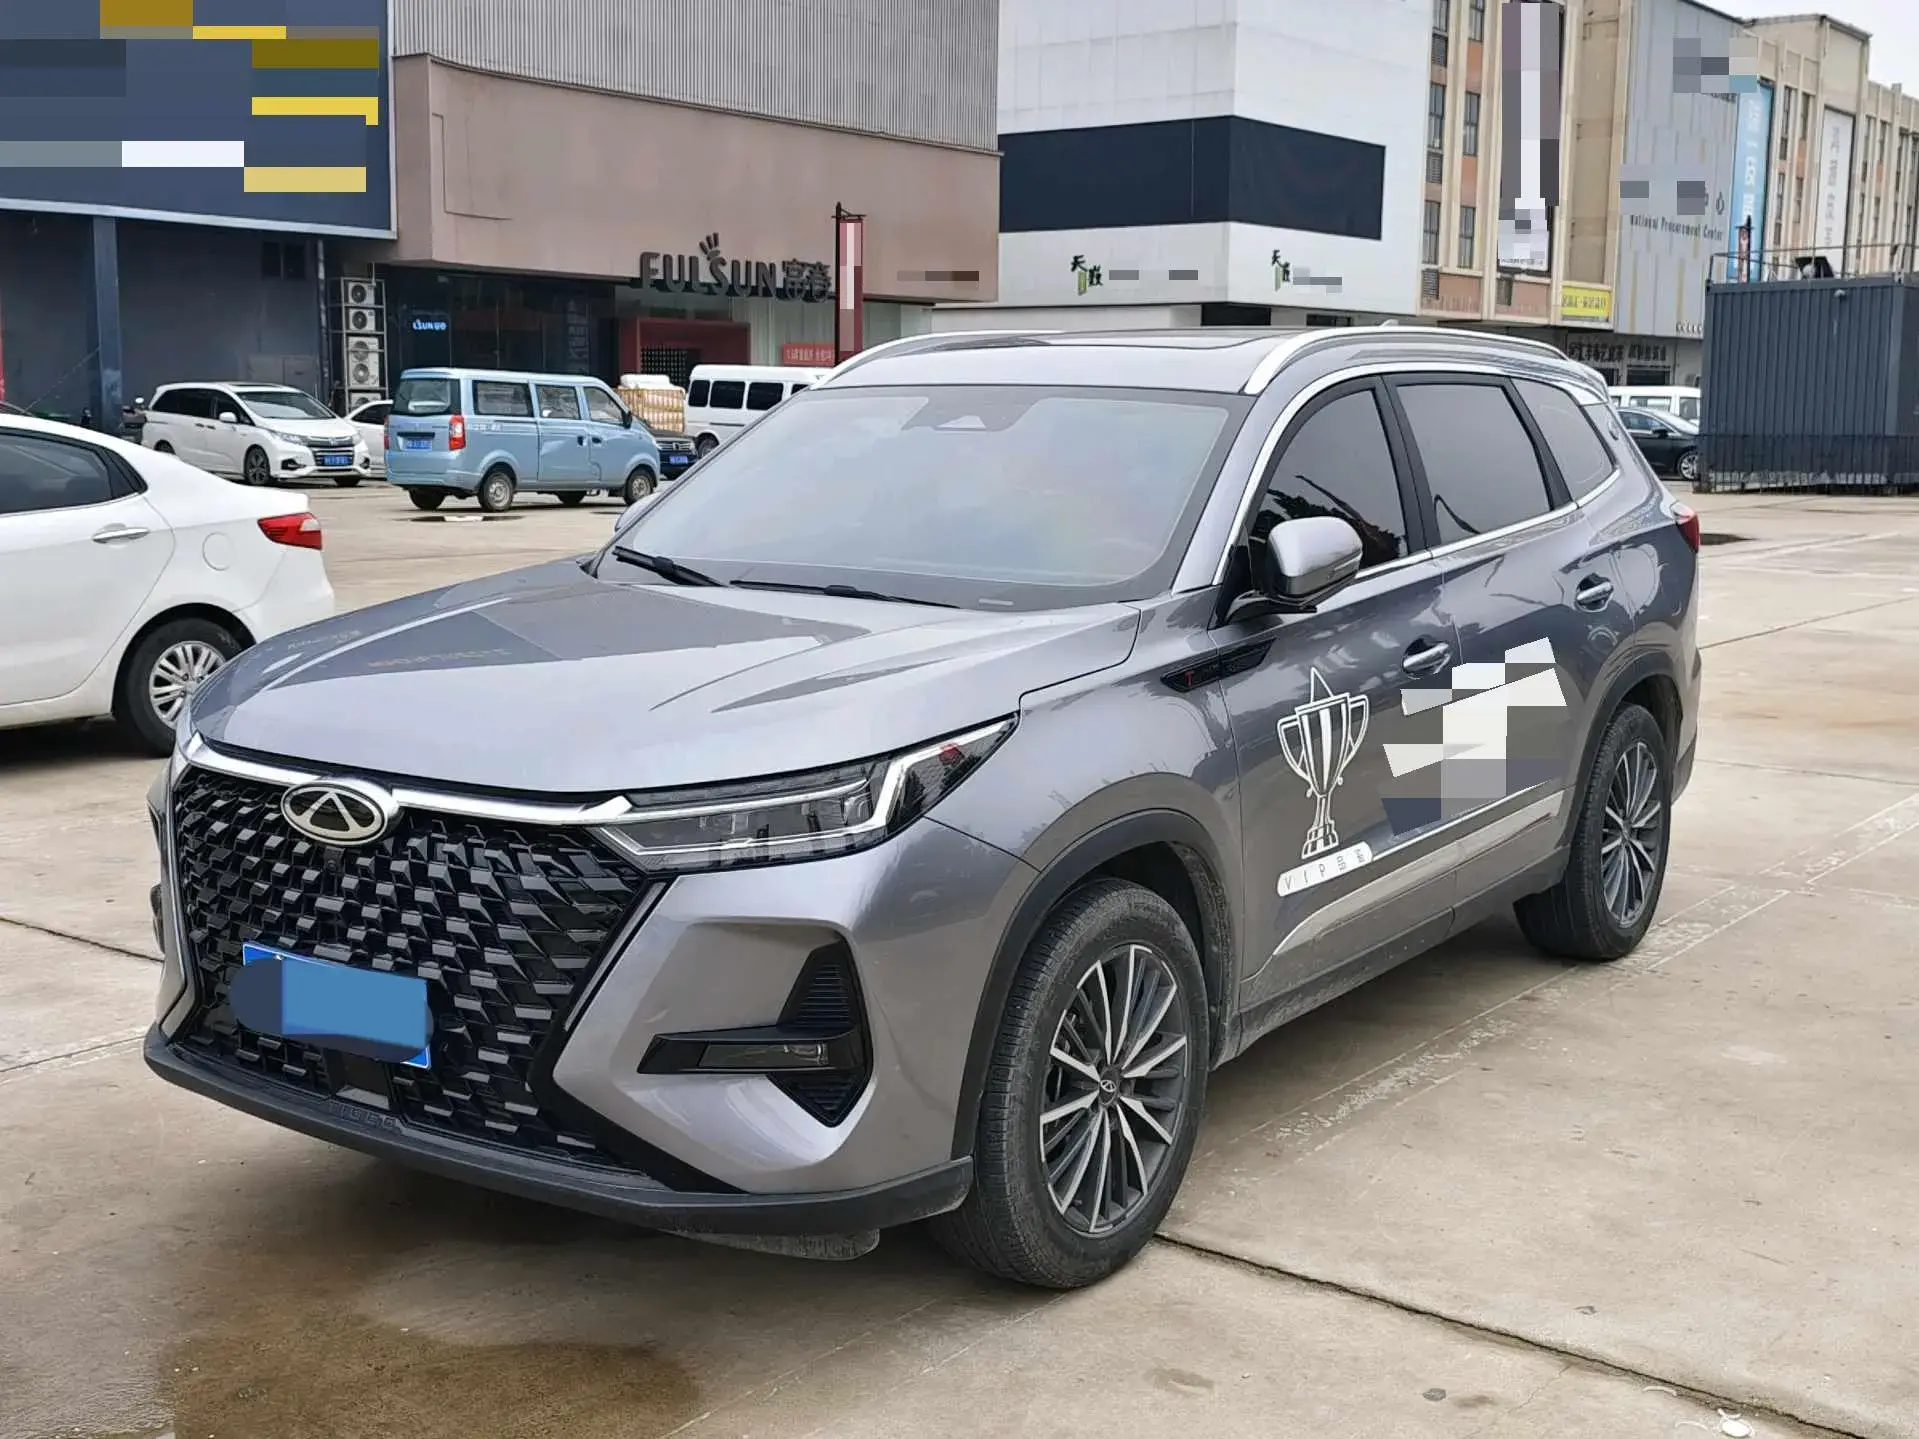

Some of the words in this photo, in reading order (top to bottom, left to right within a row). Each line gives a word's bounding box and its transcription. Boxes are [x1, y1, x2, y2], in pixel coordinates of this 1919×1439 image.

[1661, 216, 1701, 238] Procurement
[1703, 224, 1723, 241] Center
[639, 251, 776, 299] FULSUN
